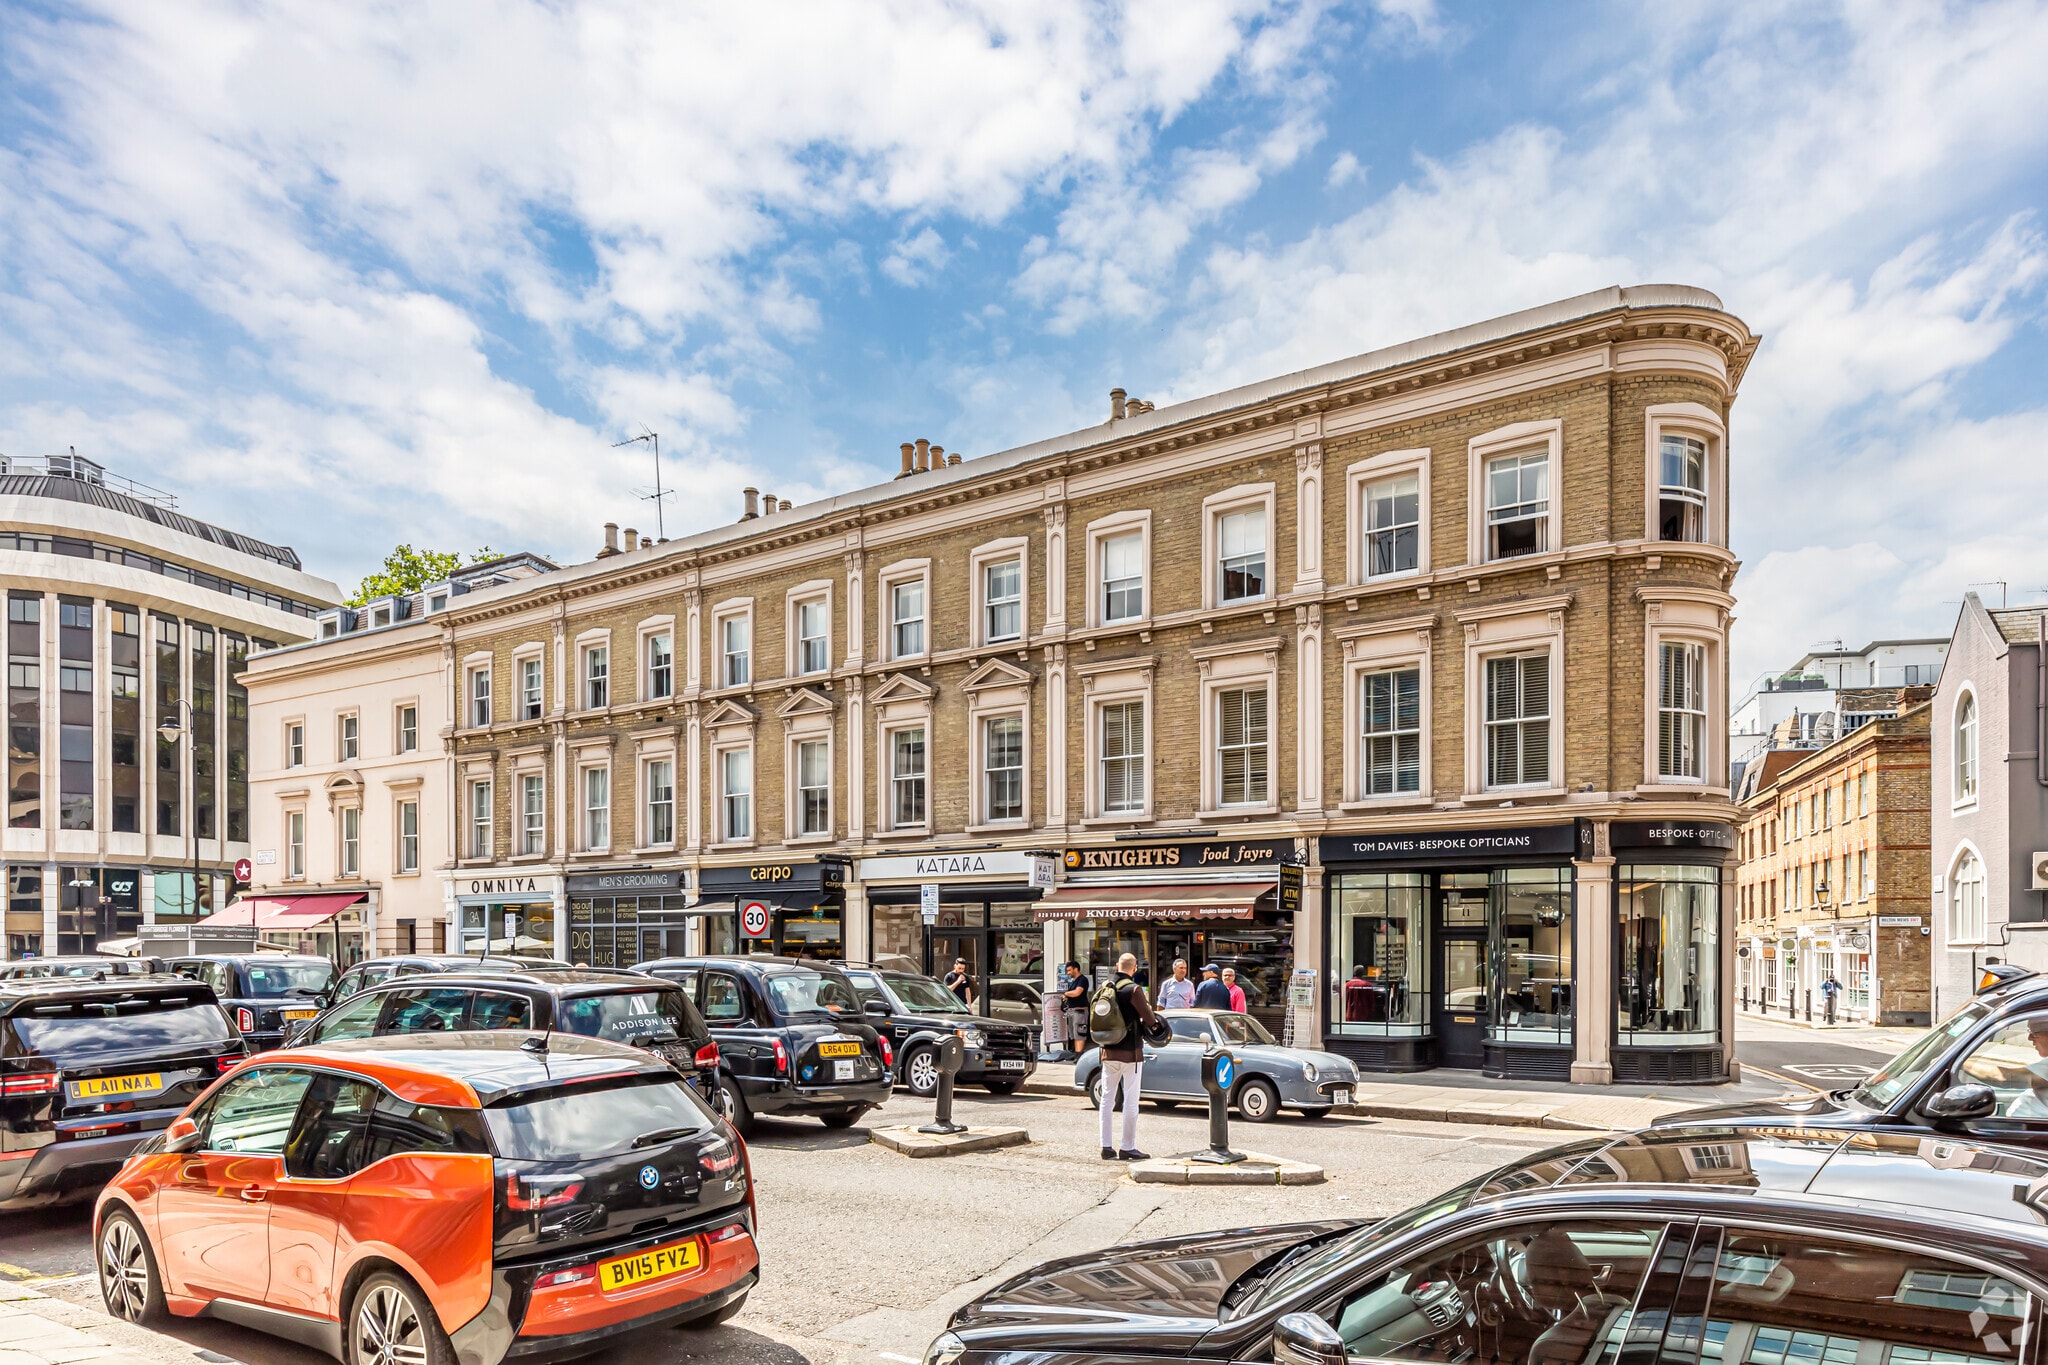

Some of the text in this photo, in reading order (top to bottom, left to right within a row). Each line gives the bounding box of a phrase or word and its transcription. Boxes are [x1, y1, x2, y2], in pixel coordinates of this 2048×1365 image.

[1649, 829, 1694, 838] BESPOKE
[1353, 836, 1530, 852] TOM DAVIES BESPOKE OPTICIANS
[1083, 848, 1180, 868] KNIGHTS
[1199, 847, 1230, 865] food
[1234, 846, 1273, 862] fayre
[917, 856, 986, 874] KATARA
[1038, 865, 1052, 873] KAT
[623, 874, 668, 886] GROOMING
[750, 866, 791, 883] carpo
[1038, 874, 1051, 882] ARA
[471, 878, 536, 894] OMNIYA
[1284, 888, 1298, 899] ATM
[469, 911, 480, 923] 3A
[1086, 909, 1145, 918] KNIGHTS
[1145, 909, 1166, 918] food
[1165, 909, 1190, 917] fayre
[1462, 908, 1470, 916] 11
[746, 912, 765, 926] 30
[594, 951, 614, 964] HUG
[612, 1017, 678, 1031] ADDISON LEE
[823, 1045, 842, 1054] LR64
[122, 1076, 153, 1090] NAA
[656, 1246, 689, 1272] FVZ
